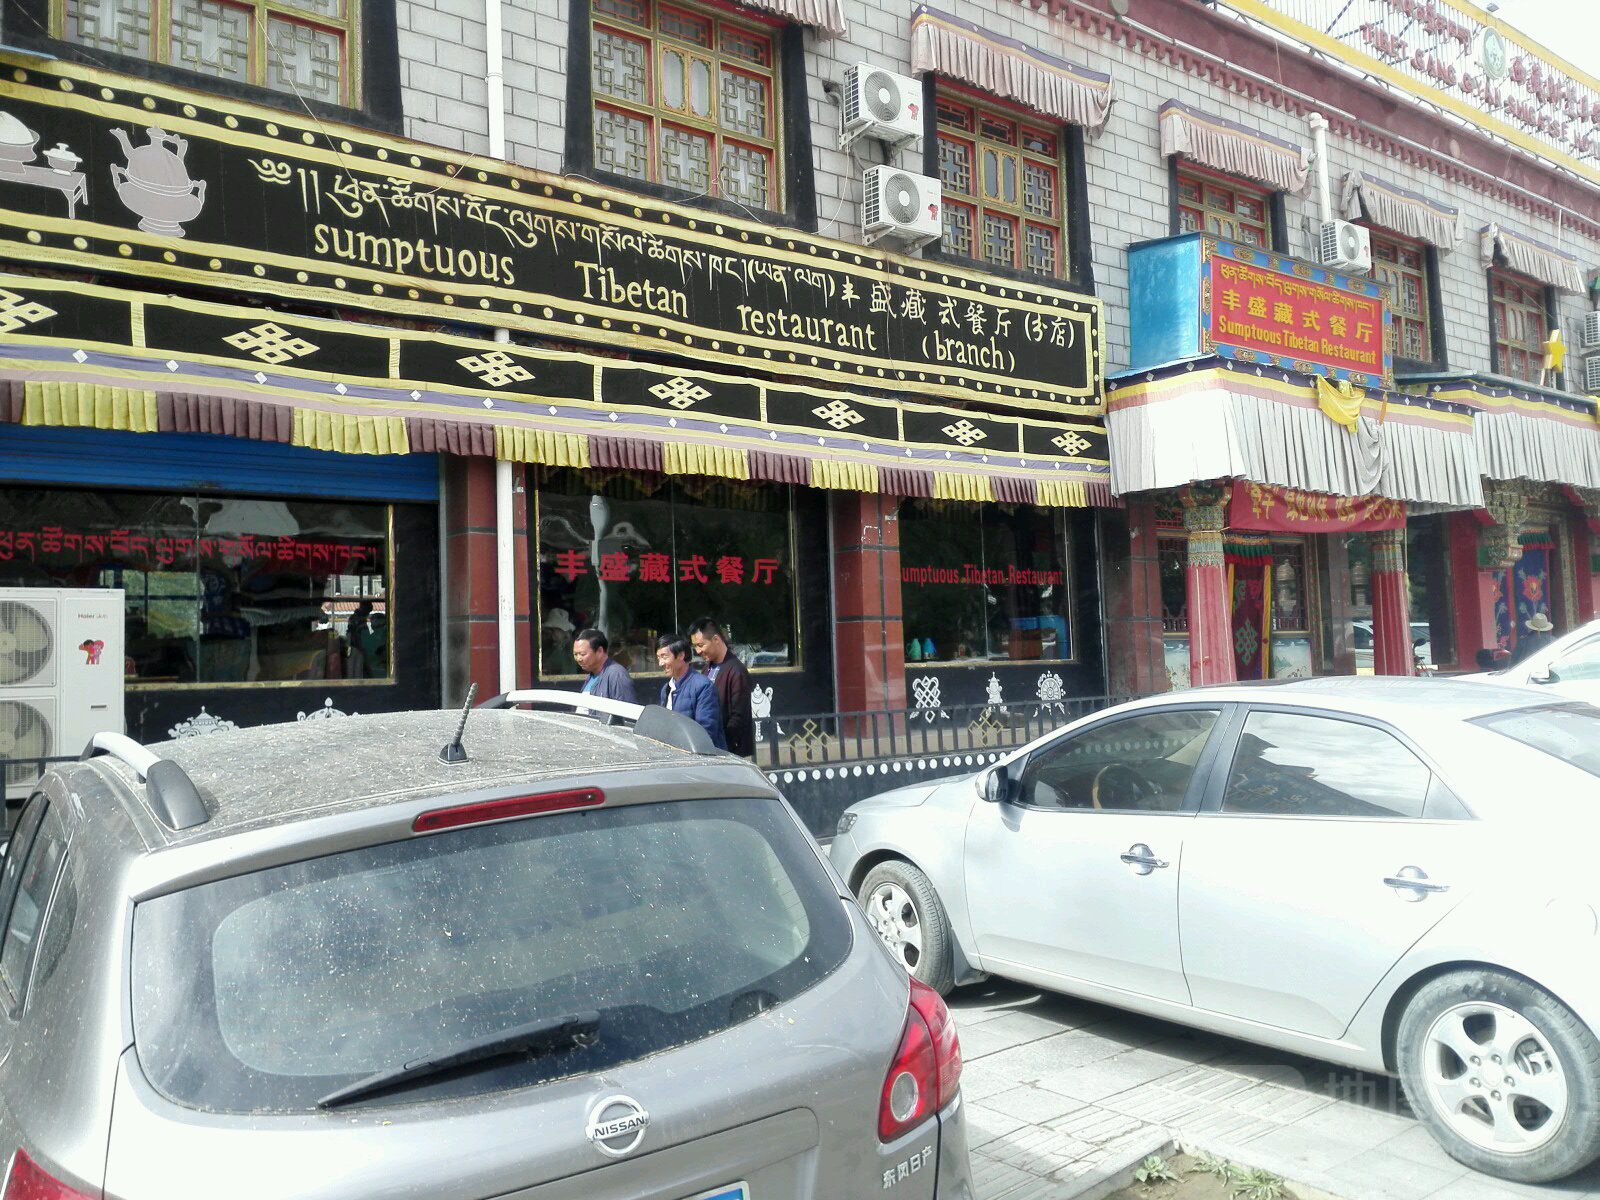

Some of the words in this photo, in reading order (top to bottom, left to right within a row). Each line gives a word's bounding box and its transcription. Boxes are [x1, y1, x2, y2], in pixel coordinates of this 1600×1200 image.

[1359, 22, 1408, 58] TIBET
[313, 223, 516, 286] sumptuous
[574, 259, 689, 319] Tibetan
[736, 303, 878, 352] restaurant
[922, 329, 1016, 373] (branch)
[1221, 288, 1374, 343] 丰盛藏式餐厅
[1218, 314, 1282, 345] Sumptuous
[1283, 329, 1320, 353] Tibetan
[1321, 337, 1377, 365] Restaurant
[554, 549, 780, 585] 丰盛藏式餐厅
[901, 565, 959, 588] umptuous
[963, 563, 1004, 585] Tibetan
[1007, 563, 1064, 585] Restaurant
[594, 1115, 645, 1137] NISSAN
[882, 1144, 933, 1189] 东风日产
